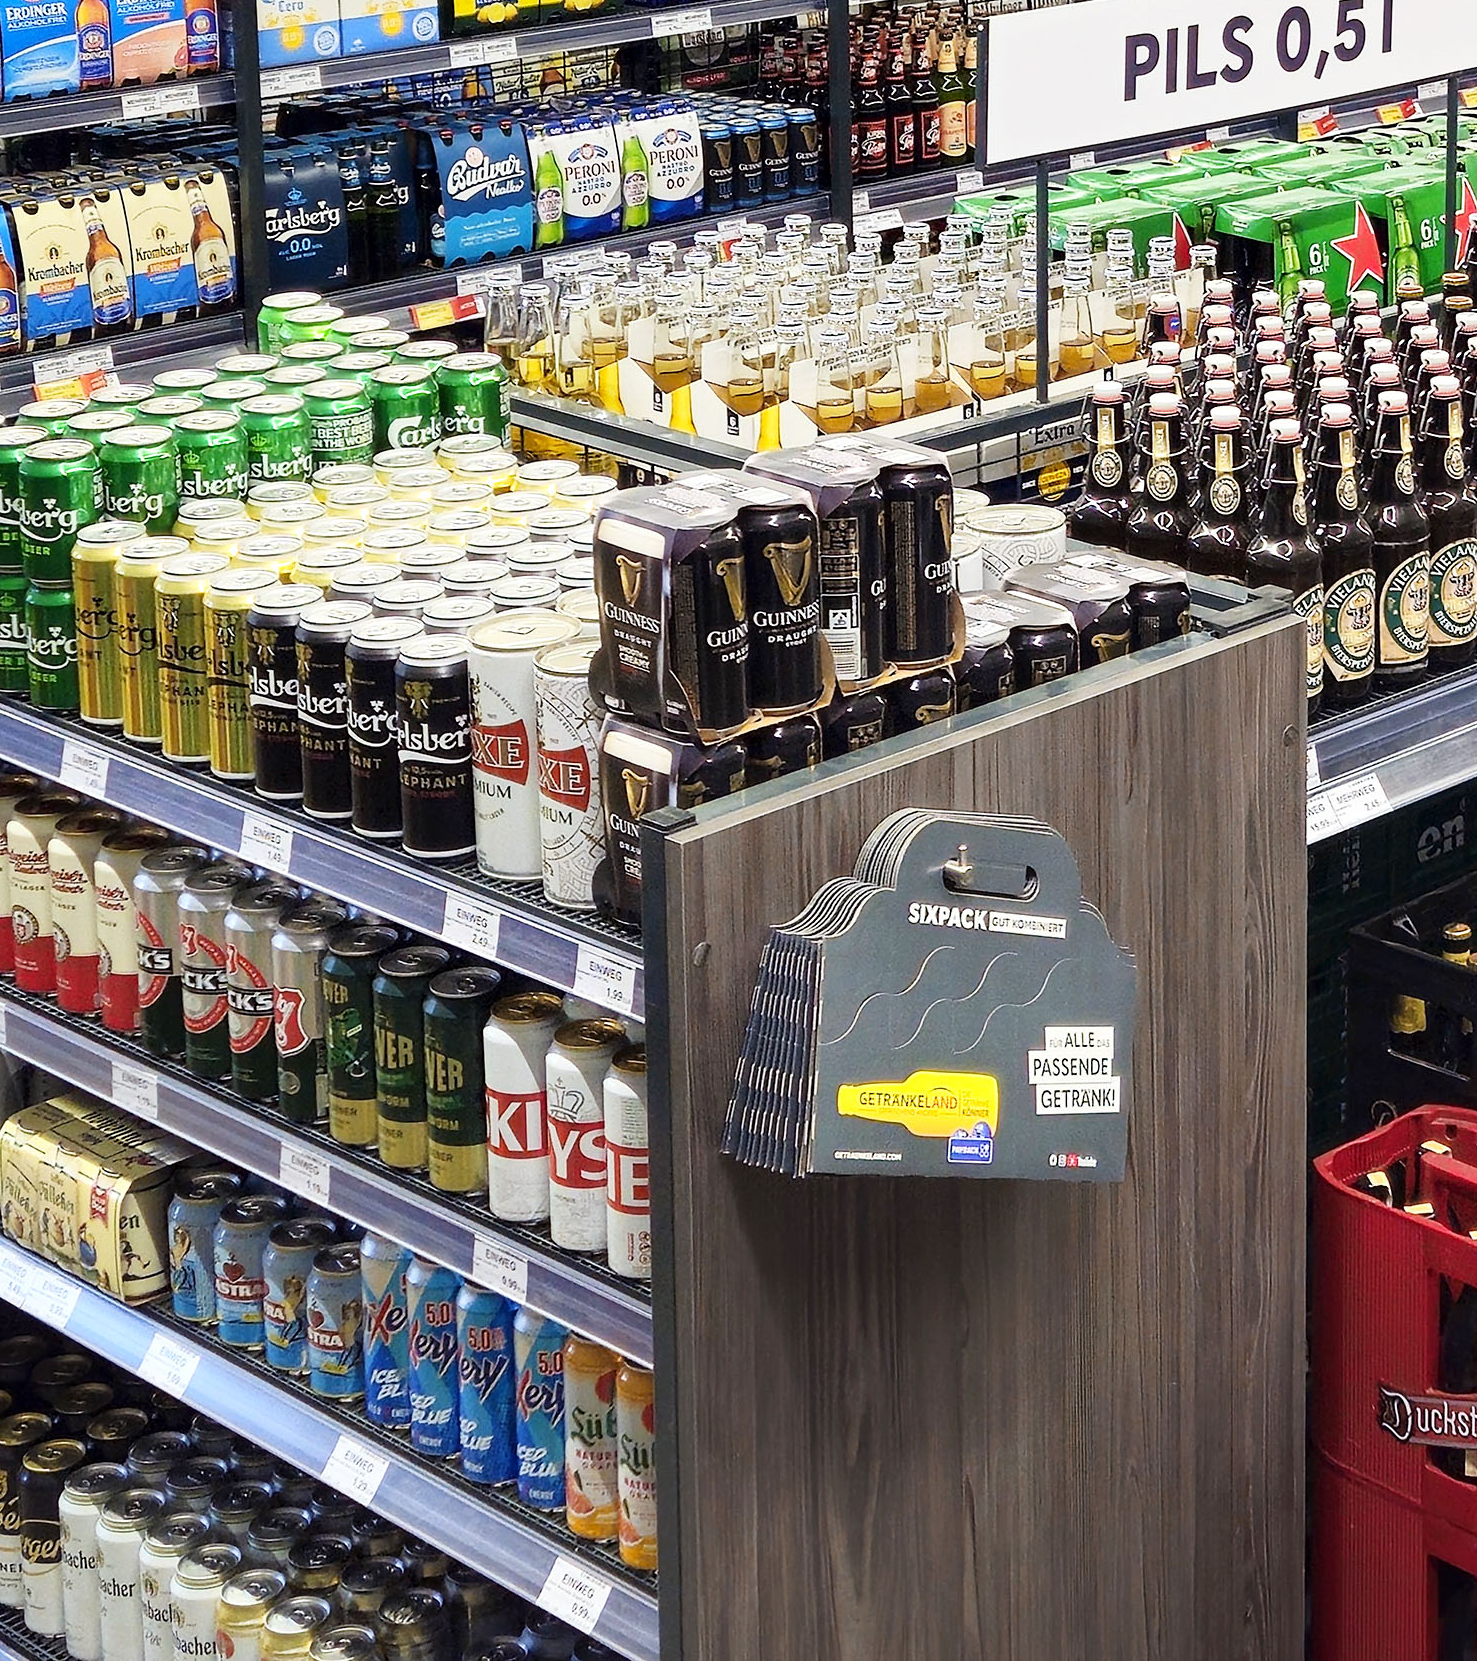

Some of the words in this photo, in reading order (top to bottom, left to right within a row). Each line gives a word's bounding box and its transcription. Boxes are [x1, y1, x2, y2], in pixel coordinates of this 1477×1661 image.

[5, 2, 66, 23] ERDINGER
[1123, 15, 1254, 101] PILS
[649, 144, 700, 166] PERONI
[447, 154, 524, 192] Budvar
[563, 160, 616, 182] PERONI
[1421, 218, 1434, 240] 6
[135, 241, 190, 262] Krombacher
[1309, 243, 1323, 265] 6
[27, 261, 86, 281] Krombacher
[319, 425, 349, 440] BEST
[604, 602, 661, 634] GUINNESS
[753, 599, 821, 629] GUINNESS
[614, 629, 653, 649] DRAUGHT
[767, 626, 817, 647] DRAUGHT
[457, 907, 489, 929] EINWEG
[907, 901, 988, 931] SIXPACK
[991, 916, 1011, 930] GUT
[1012, 919, 1065, 936] KOMBINIERT
[589, 958, 623, 981] EINWEG
[1064, 1031, 1095, 1049] ALLE
[1033, 1057, 1109, 1077] PASSENDE
[859, 1091, 958, 1111] GETRÄNKELAND
[1041, 1086, 1116, 1109] GETRÄNK!
[485, 1248, 517, 1273] EINWEG
[345, 1449, 374, 1473] EINWEG
[561, 1573, 595, 1599] EINWEG
